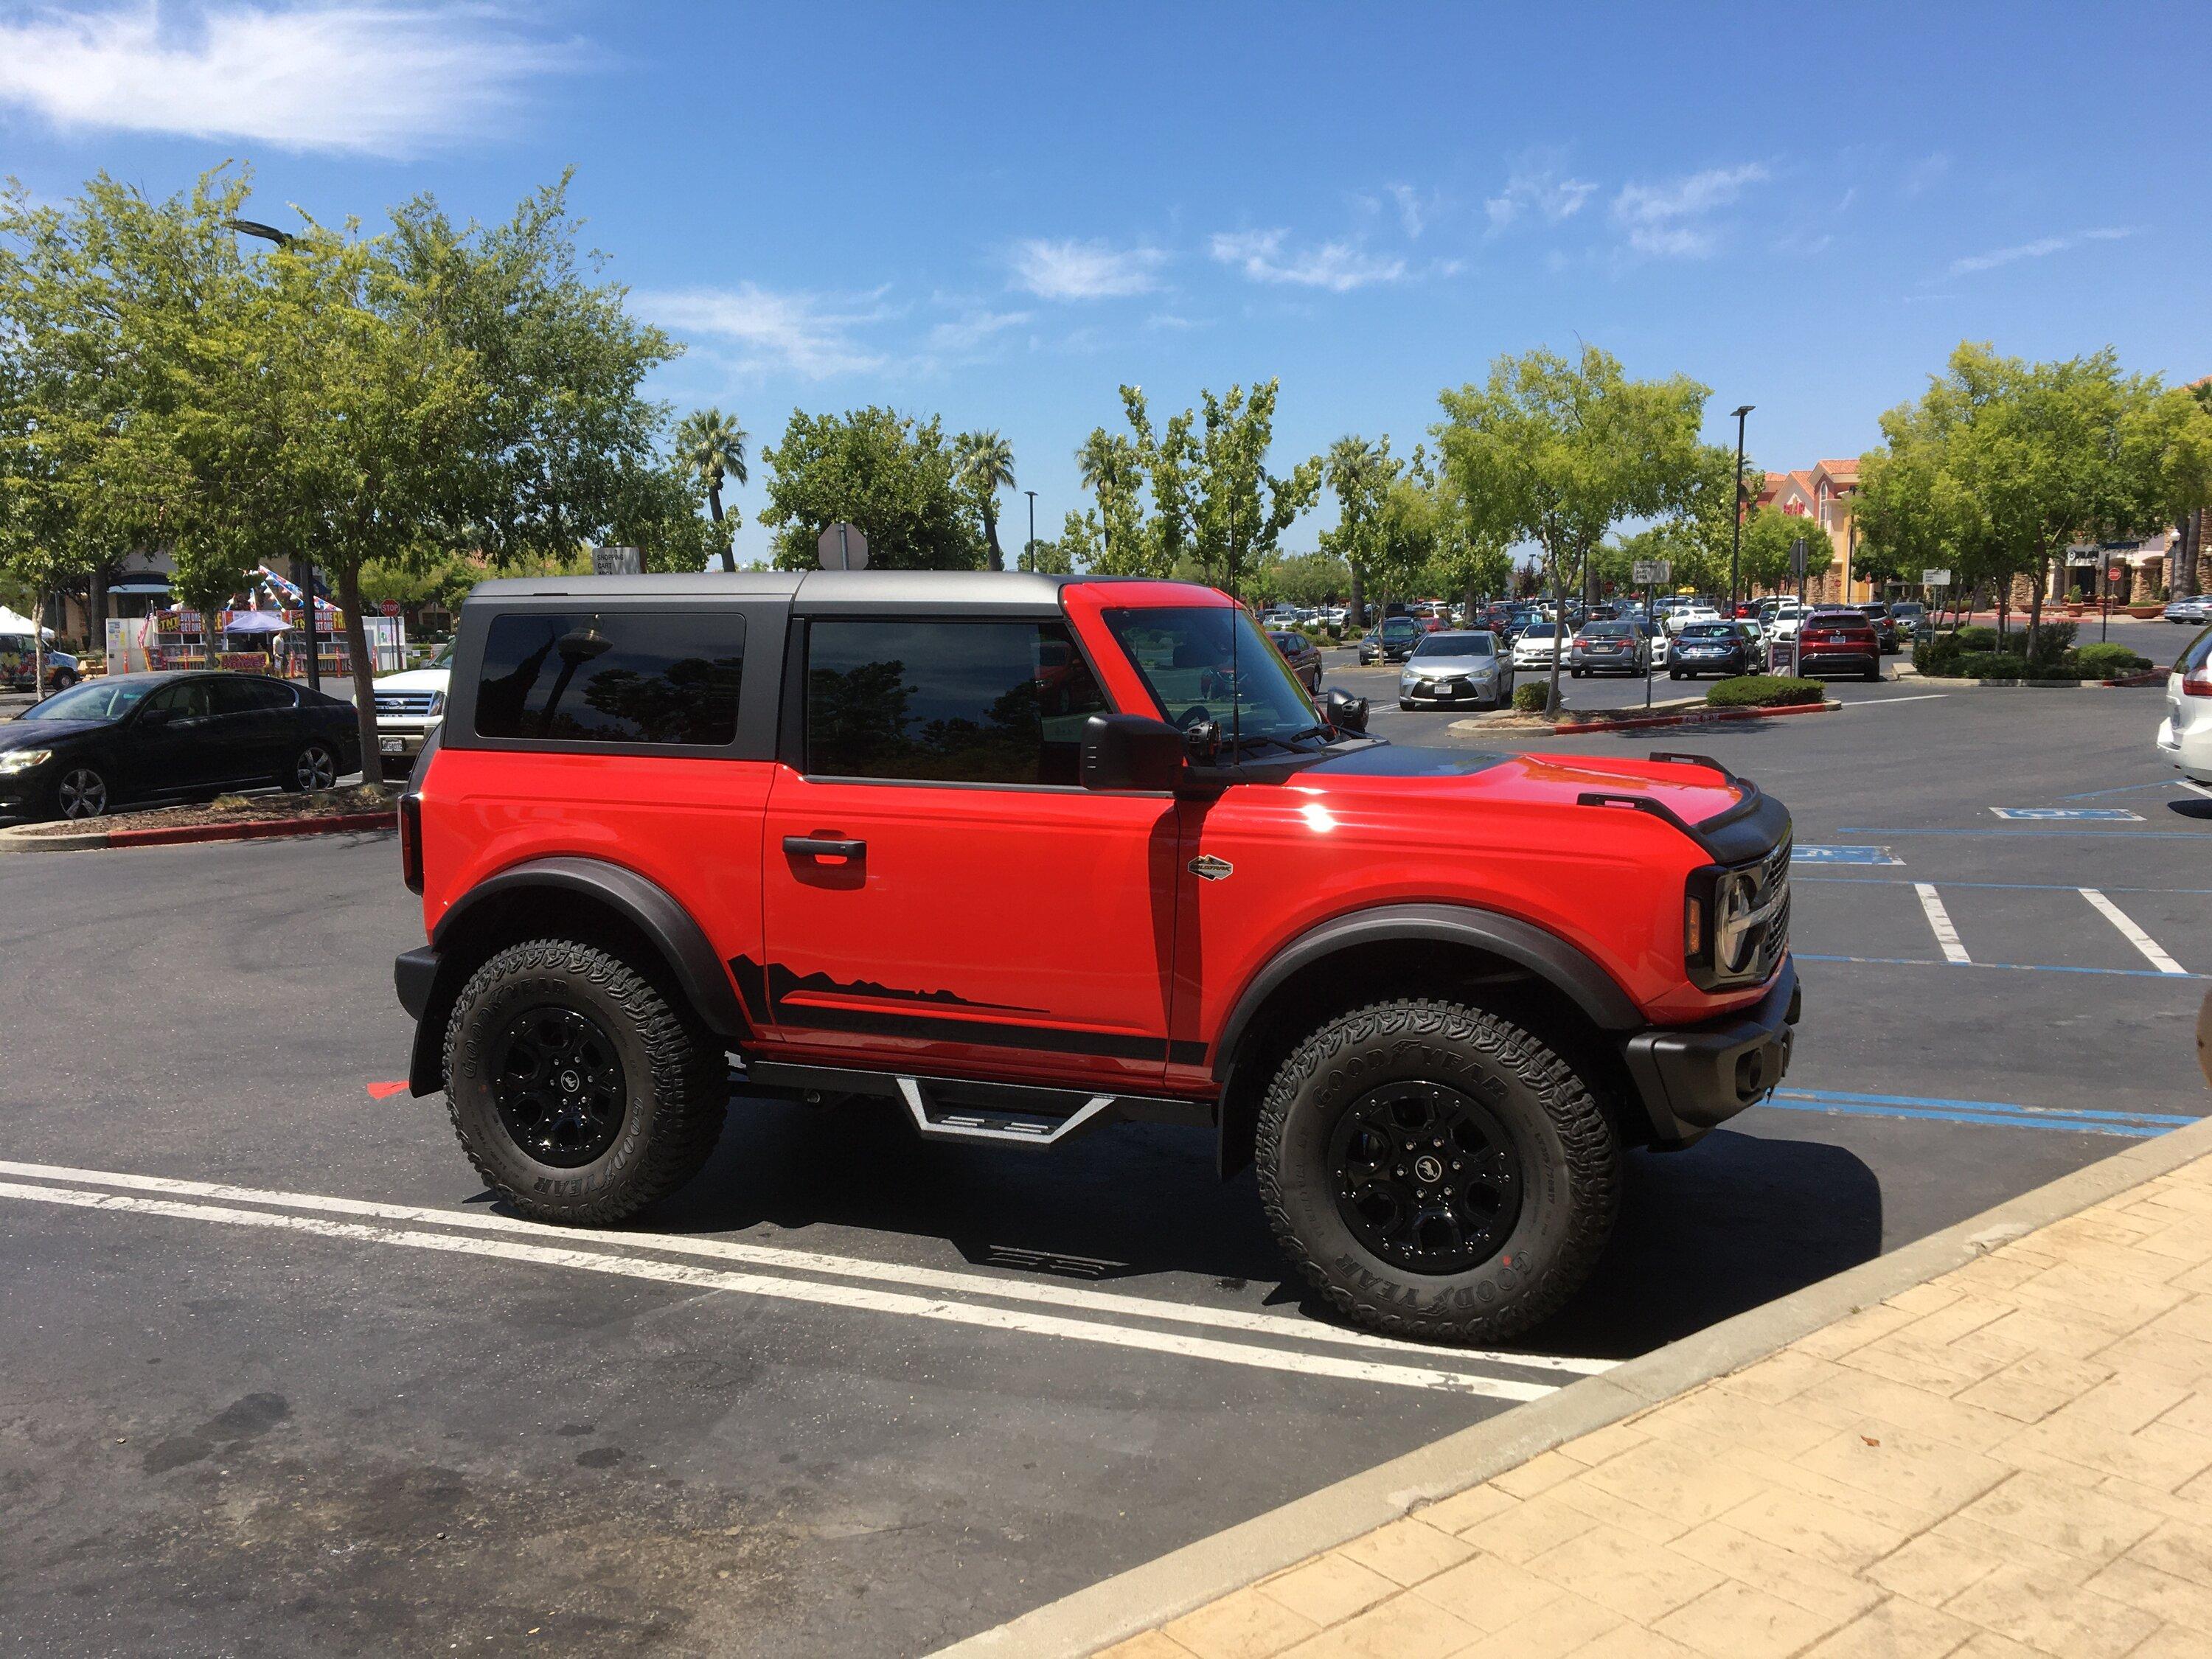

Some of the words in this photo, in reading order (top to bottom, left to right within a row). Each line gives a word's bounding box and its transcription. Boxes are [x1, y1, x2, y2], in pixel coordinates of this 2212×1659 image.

[181, 613, 191, 622] BUY
[192, 613, 201, 622] ONE
[324, 611, 333, 621] ONE
[159, 616, 179, 630] TNT
[181, 623, 191, 632] GET
[192, 623, 201, 632] ONE
[324, 622, 333, 630] ONE
[1312, 1041, 1509, 1109] GOODYEAR
[1334, 1251, 1533, 1313] GOODYEAR
